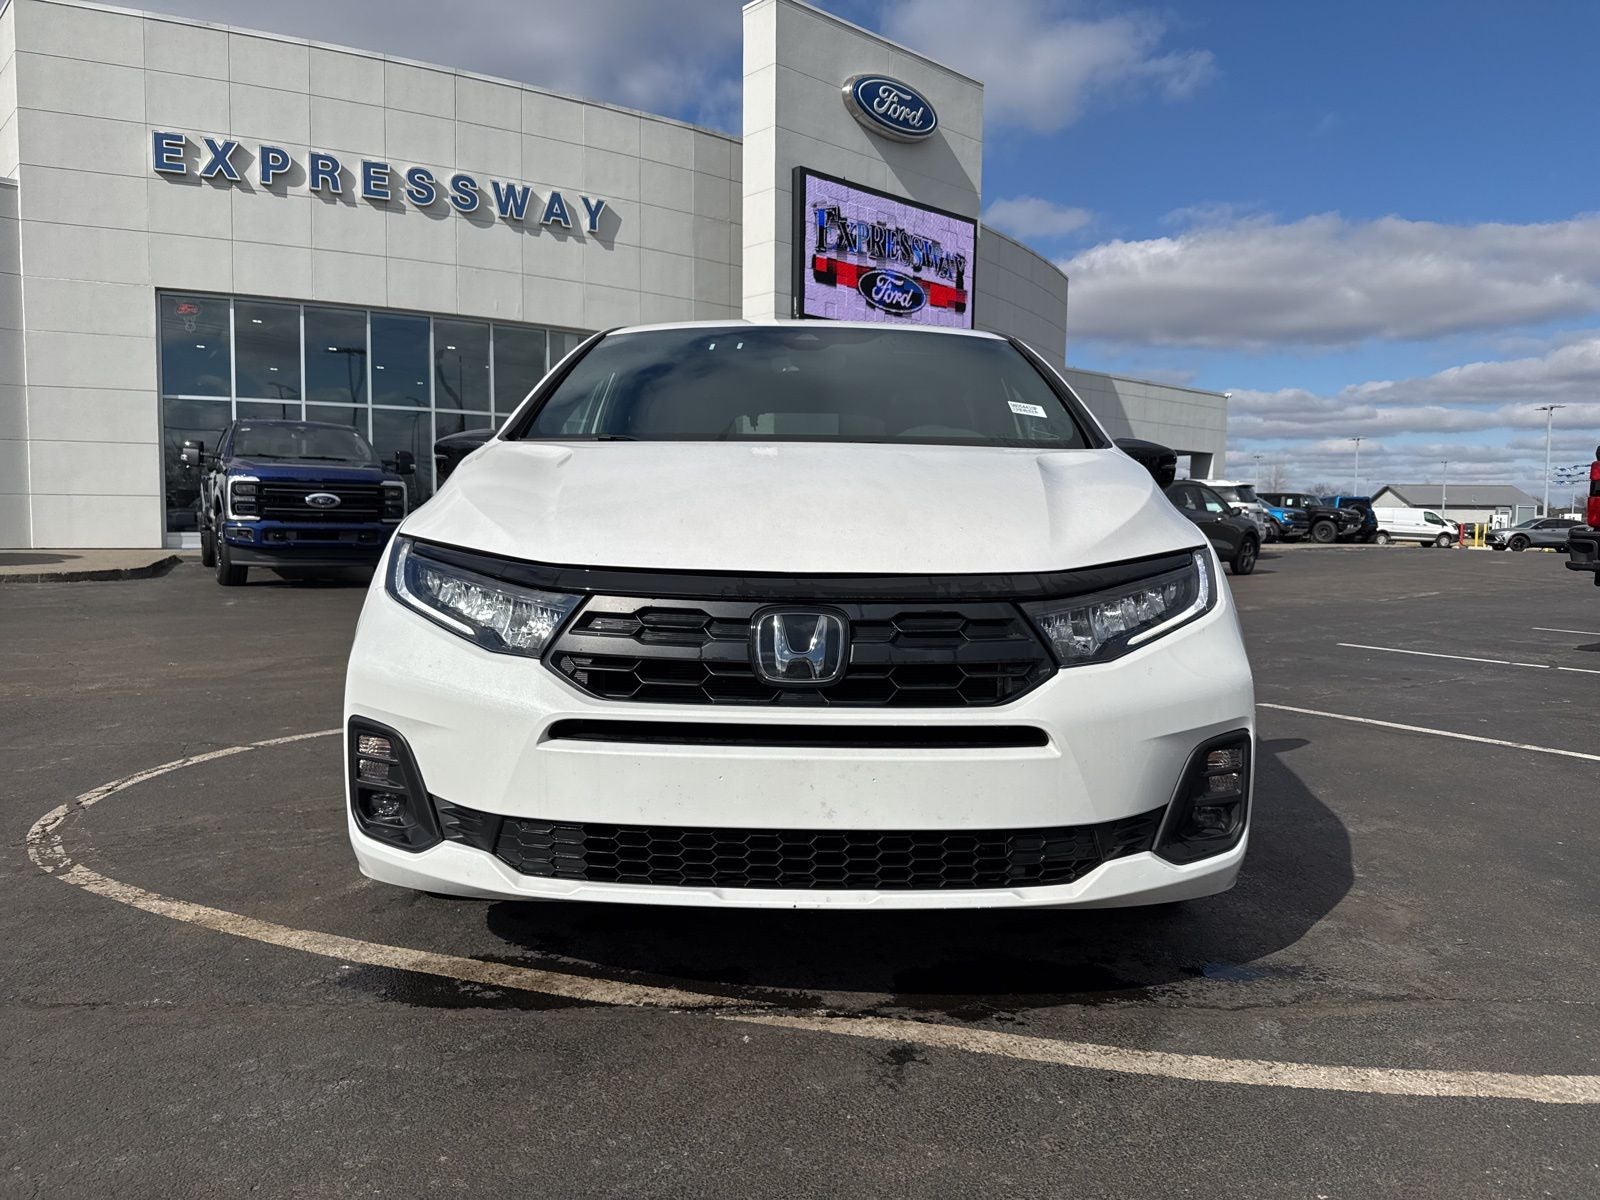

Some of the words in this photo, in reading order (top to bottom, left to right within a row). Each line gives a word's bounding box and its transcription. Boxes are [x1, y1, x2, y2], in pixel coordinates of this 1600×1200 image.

[873, 85, 924, 128] Ford
[152, 130, 607, 234] EXPRESSWAY
[871, 274, 914, 308] Ford
